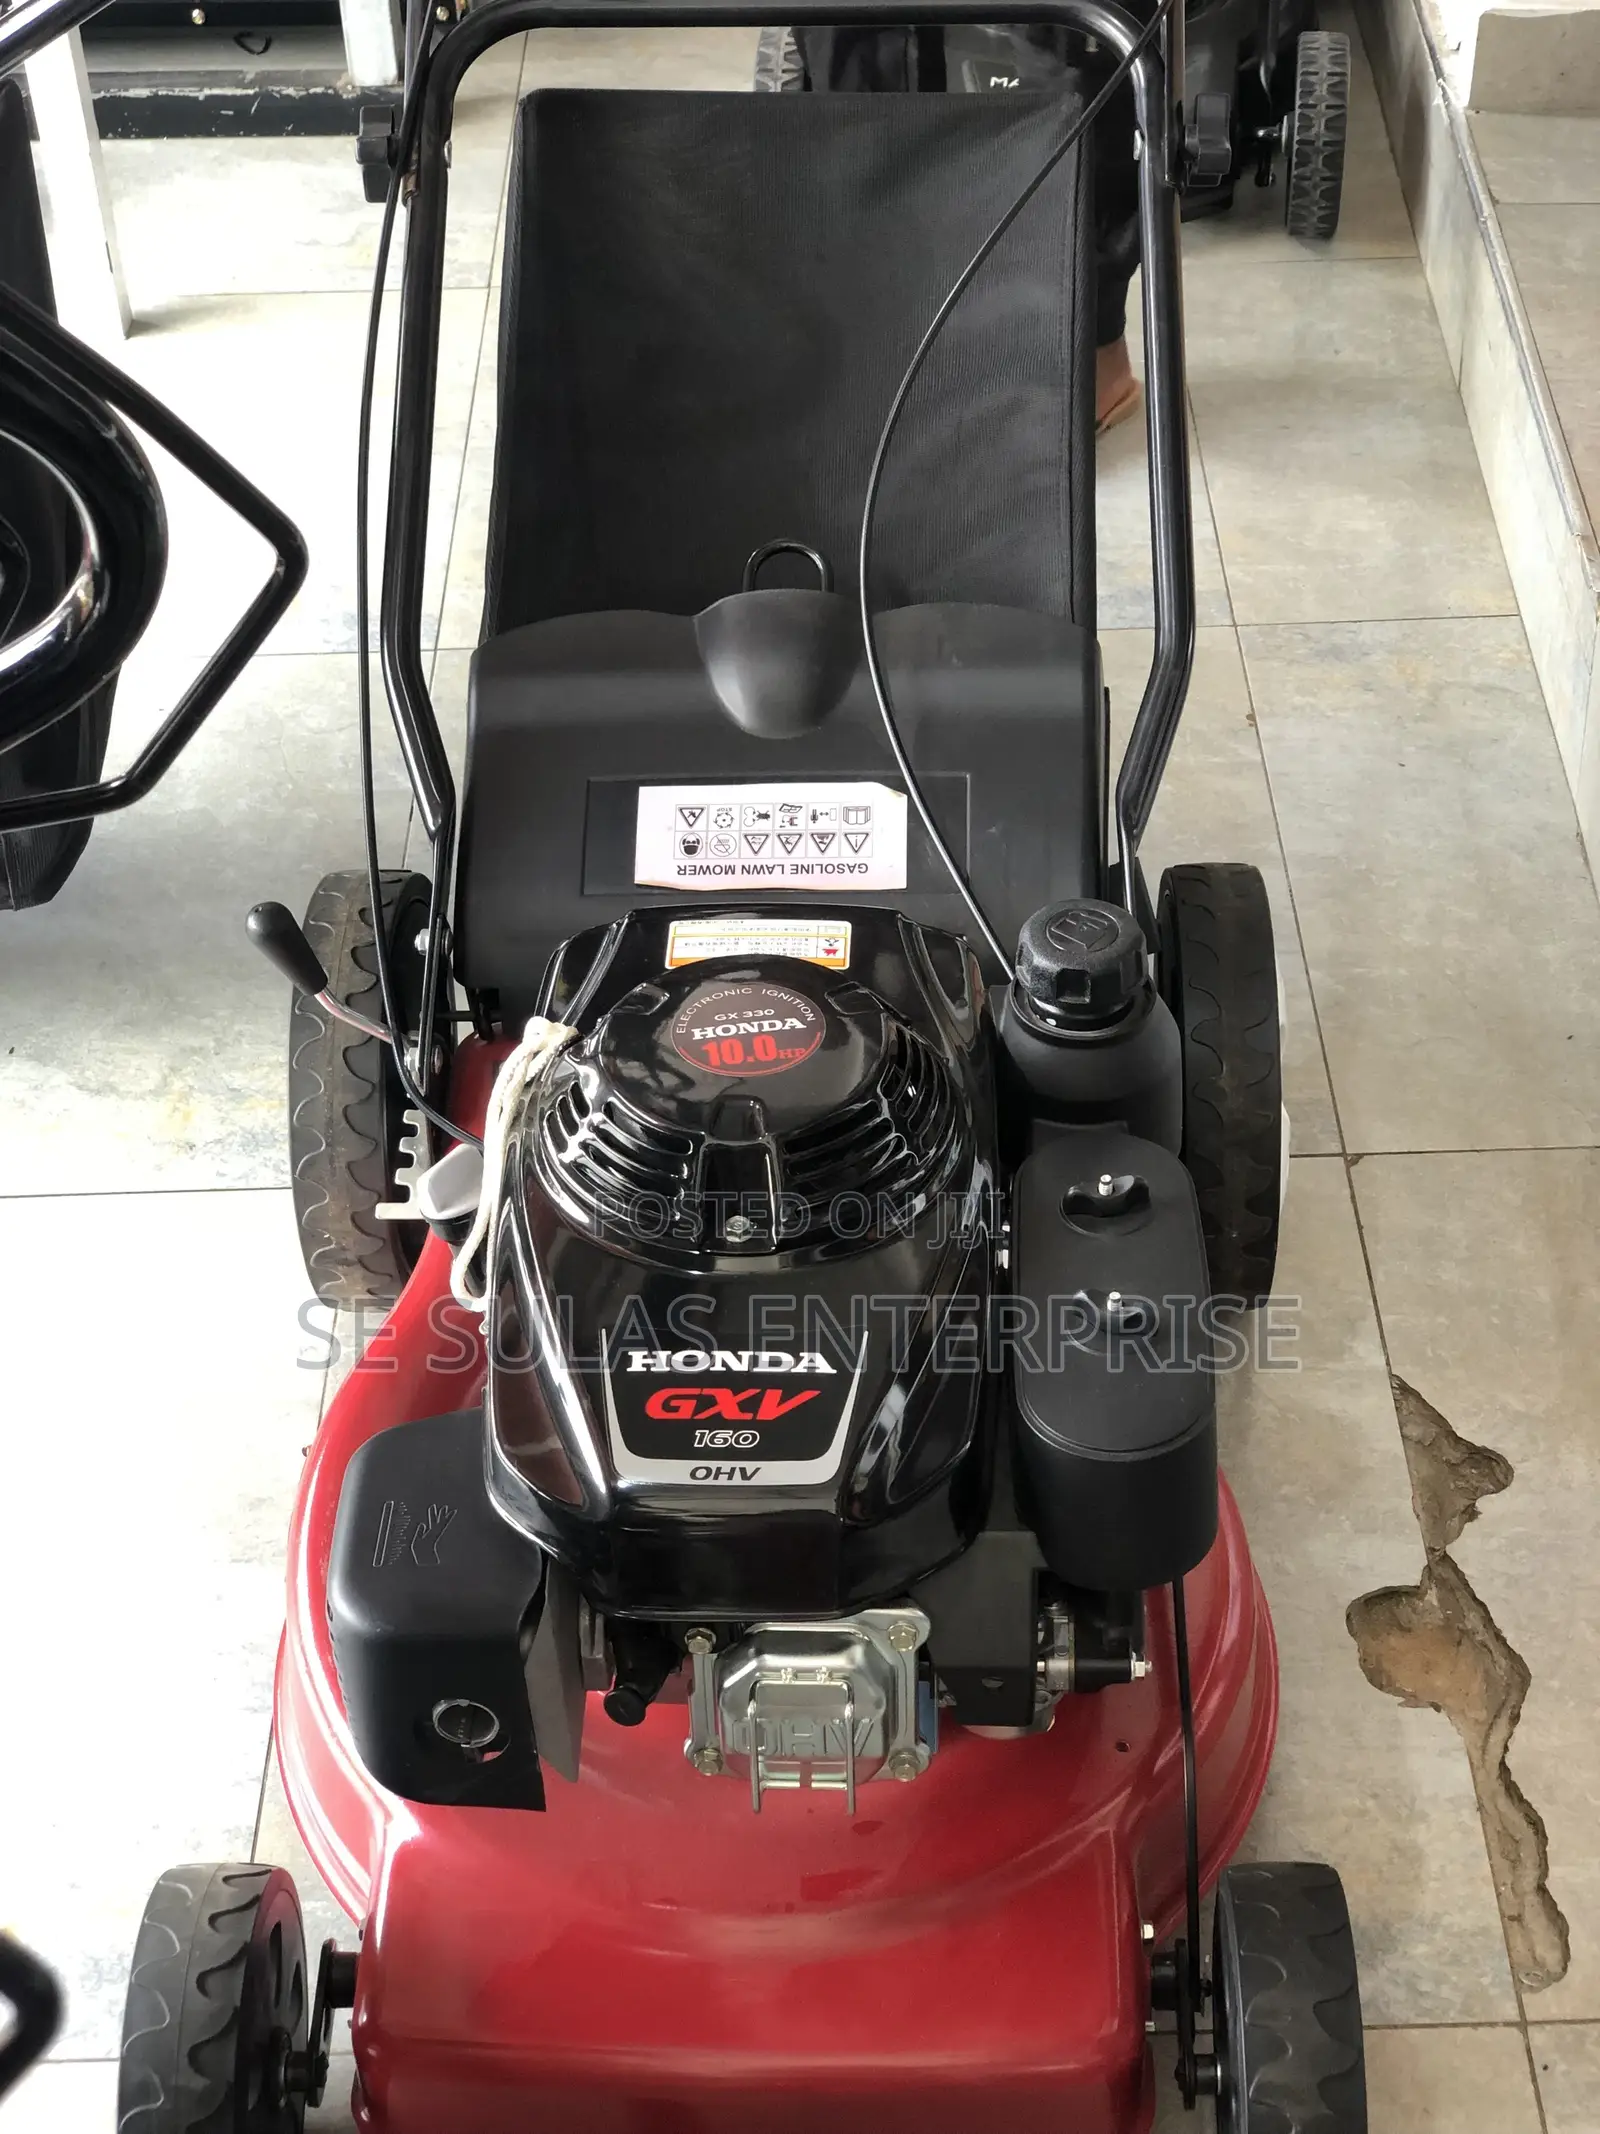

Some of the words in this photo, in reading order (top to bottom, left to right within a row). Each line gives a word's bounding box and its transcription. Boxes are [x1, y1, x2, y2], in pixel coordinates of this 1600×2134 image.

[676, 864, 736, 876] MOWER
[740, 863, 785, 875] LAWN
[789, 863, 869, 875] GASOLINE
[676, 987, 753, 1034] ELECTRONIC
[761, 988, 817, 1022] IGNITION
[714, 1012, 739, 1022] GX
[743, 1008, 775, 1019] 330
[691, 1017, 807, 1041] HONDA
[626, 1350, 837, 1373] HONDA
[645, 1387, 821, 1420] GXV
[693, 1430, 760, 1448] 160
[689, 1466, 761, 1481] OHV
